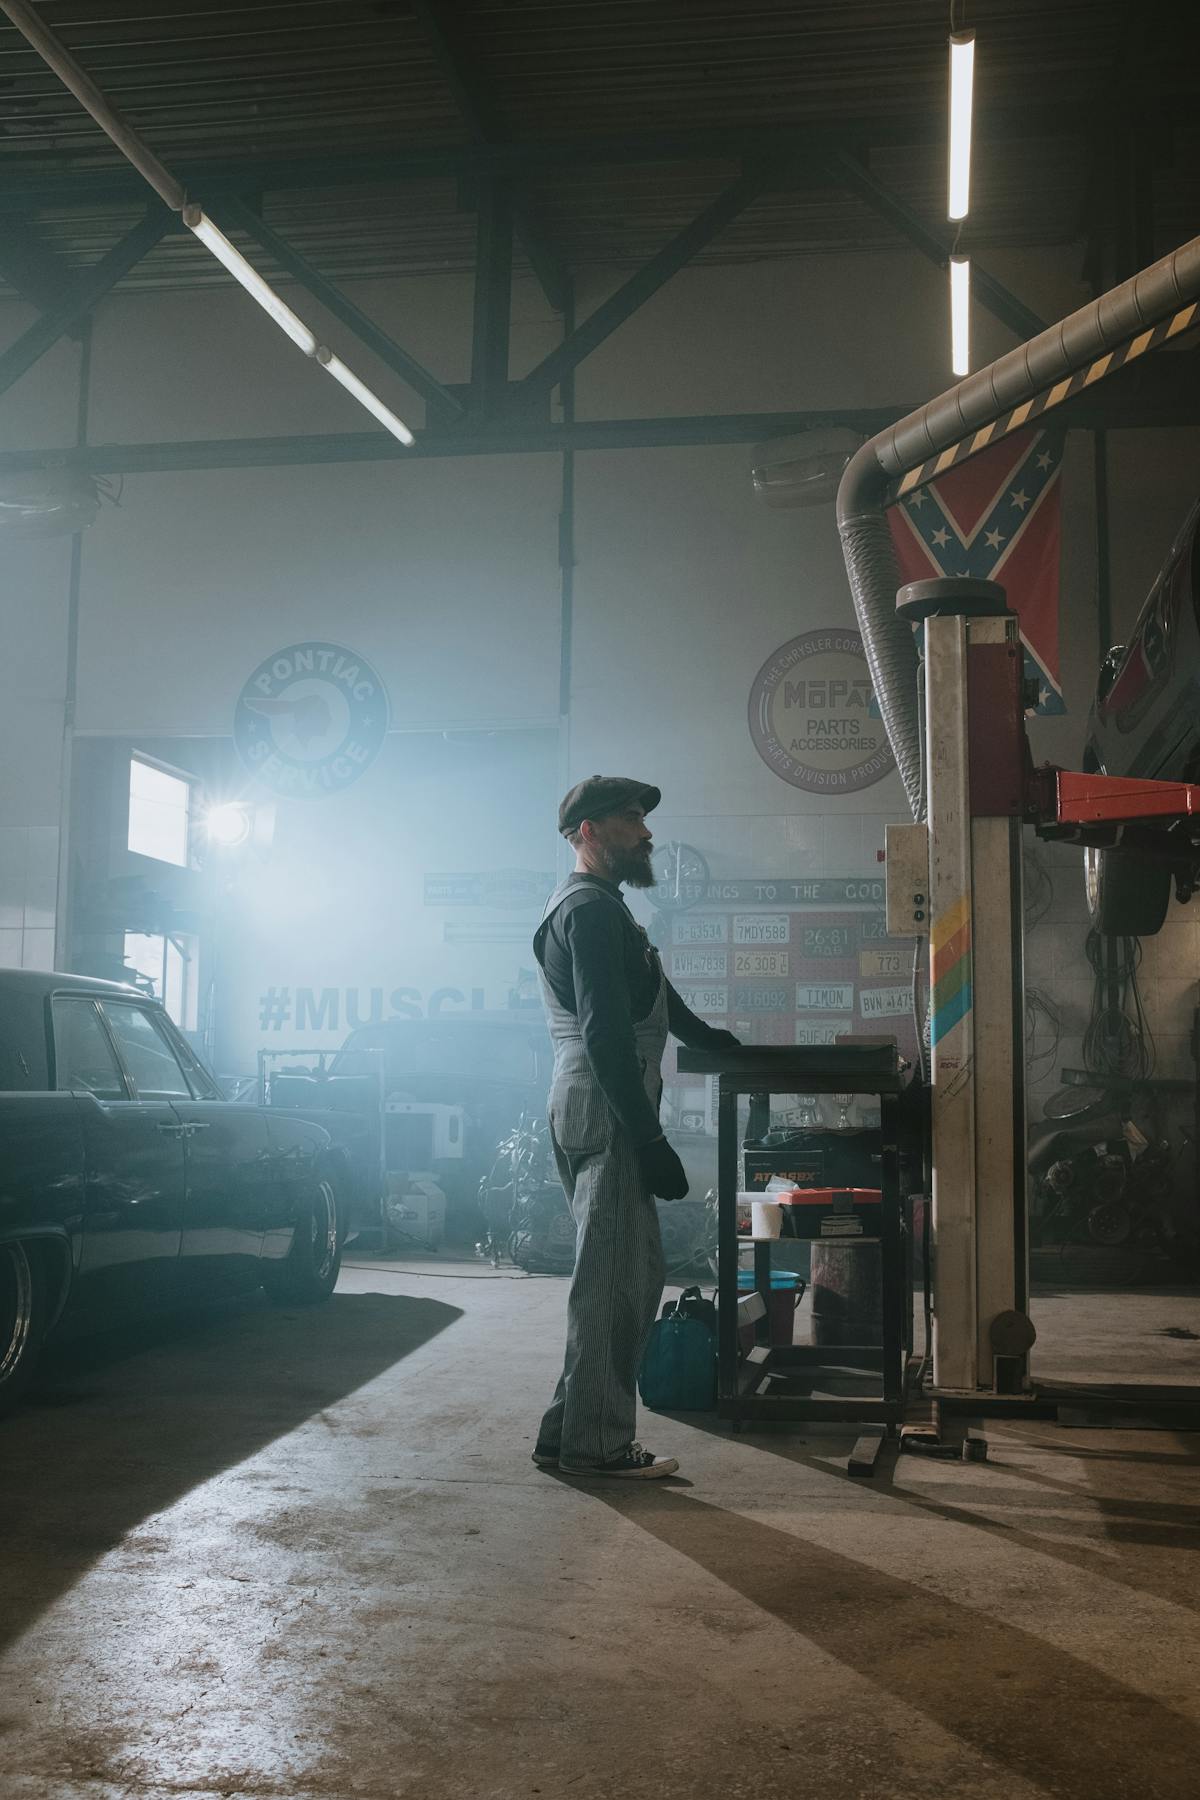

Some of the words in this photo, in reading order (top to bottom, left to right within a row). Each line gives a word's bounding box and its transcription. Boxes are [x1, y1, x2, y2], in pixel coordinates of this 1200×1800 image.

[763, 666, 783, 687] THE
[782, 638, 832, 669] CHRYSLER
[253, 649, 374, 701] PONTIAC
[807, 719, 860, 735] PARTS
[789, 737, 877, 751] ACCESSORIES
[247, 740, 369, 790] SERVICE
[766, 737, 793, 769] PARTS
[793, 765, 847, 785] DIVISION
[753, 884, 777, 900] TO
[790, 884, 820, 900] THE
[703, 992, 725, 1007] 985
[753, 1172, 816, 1182] ATASBX
